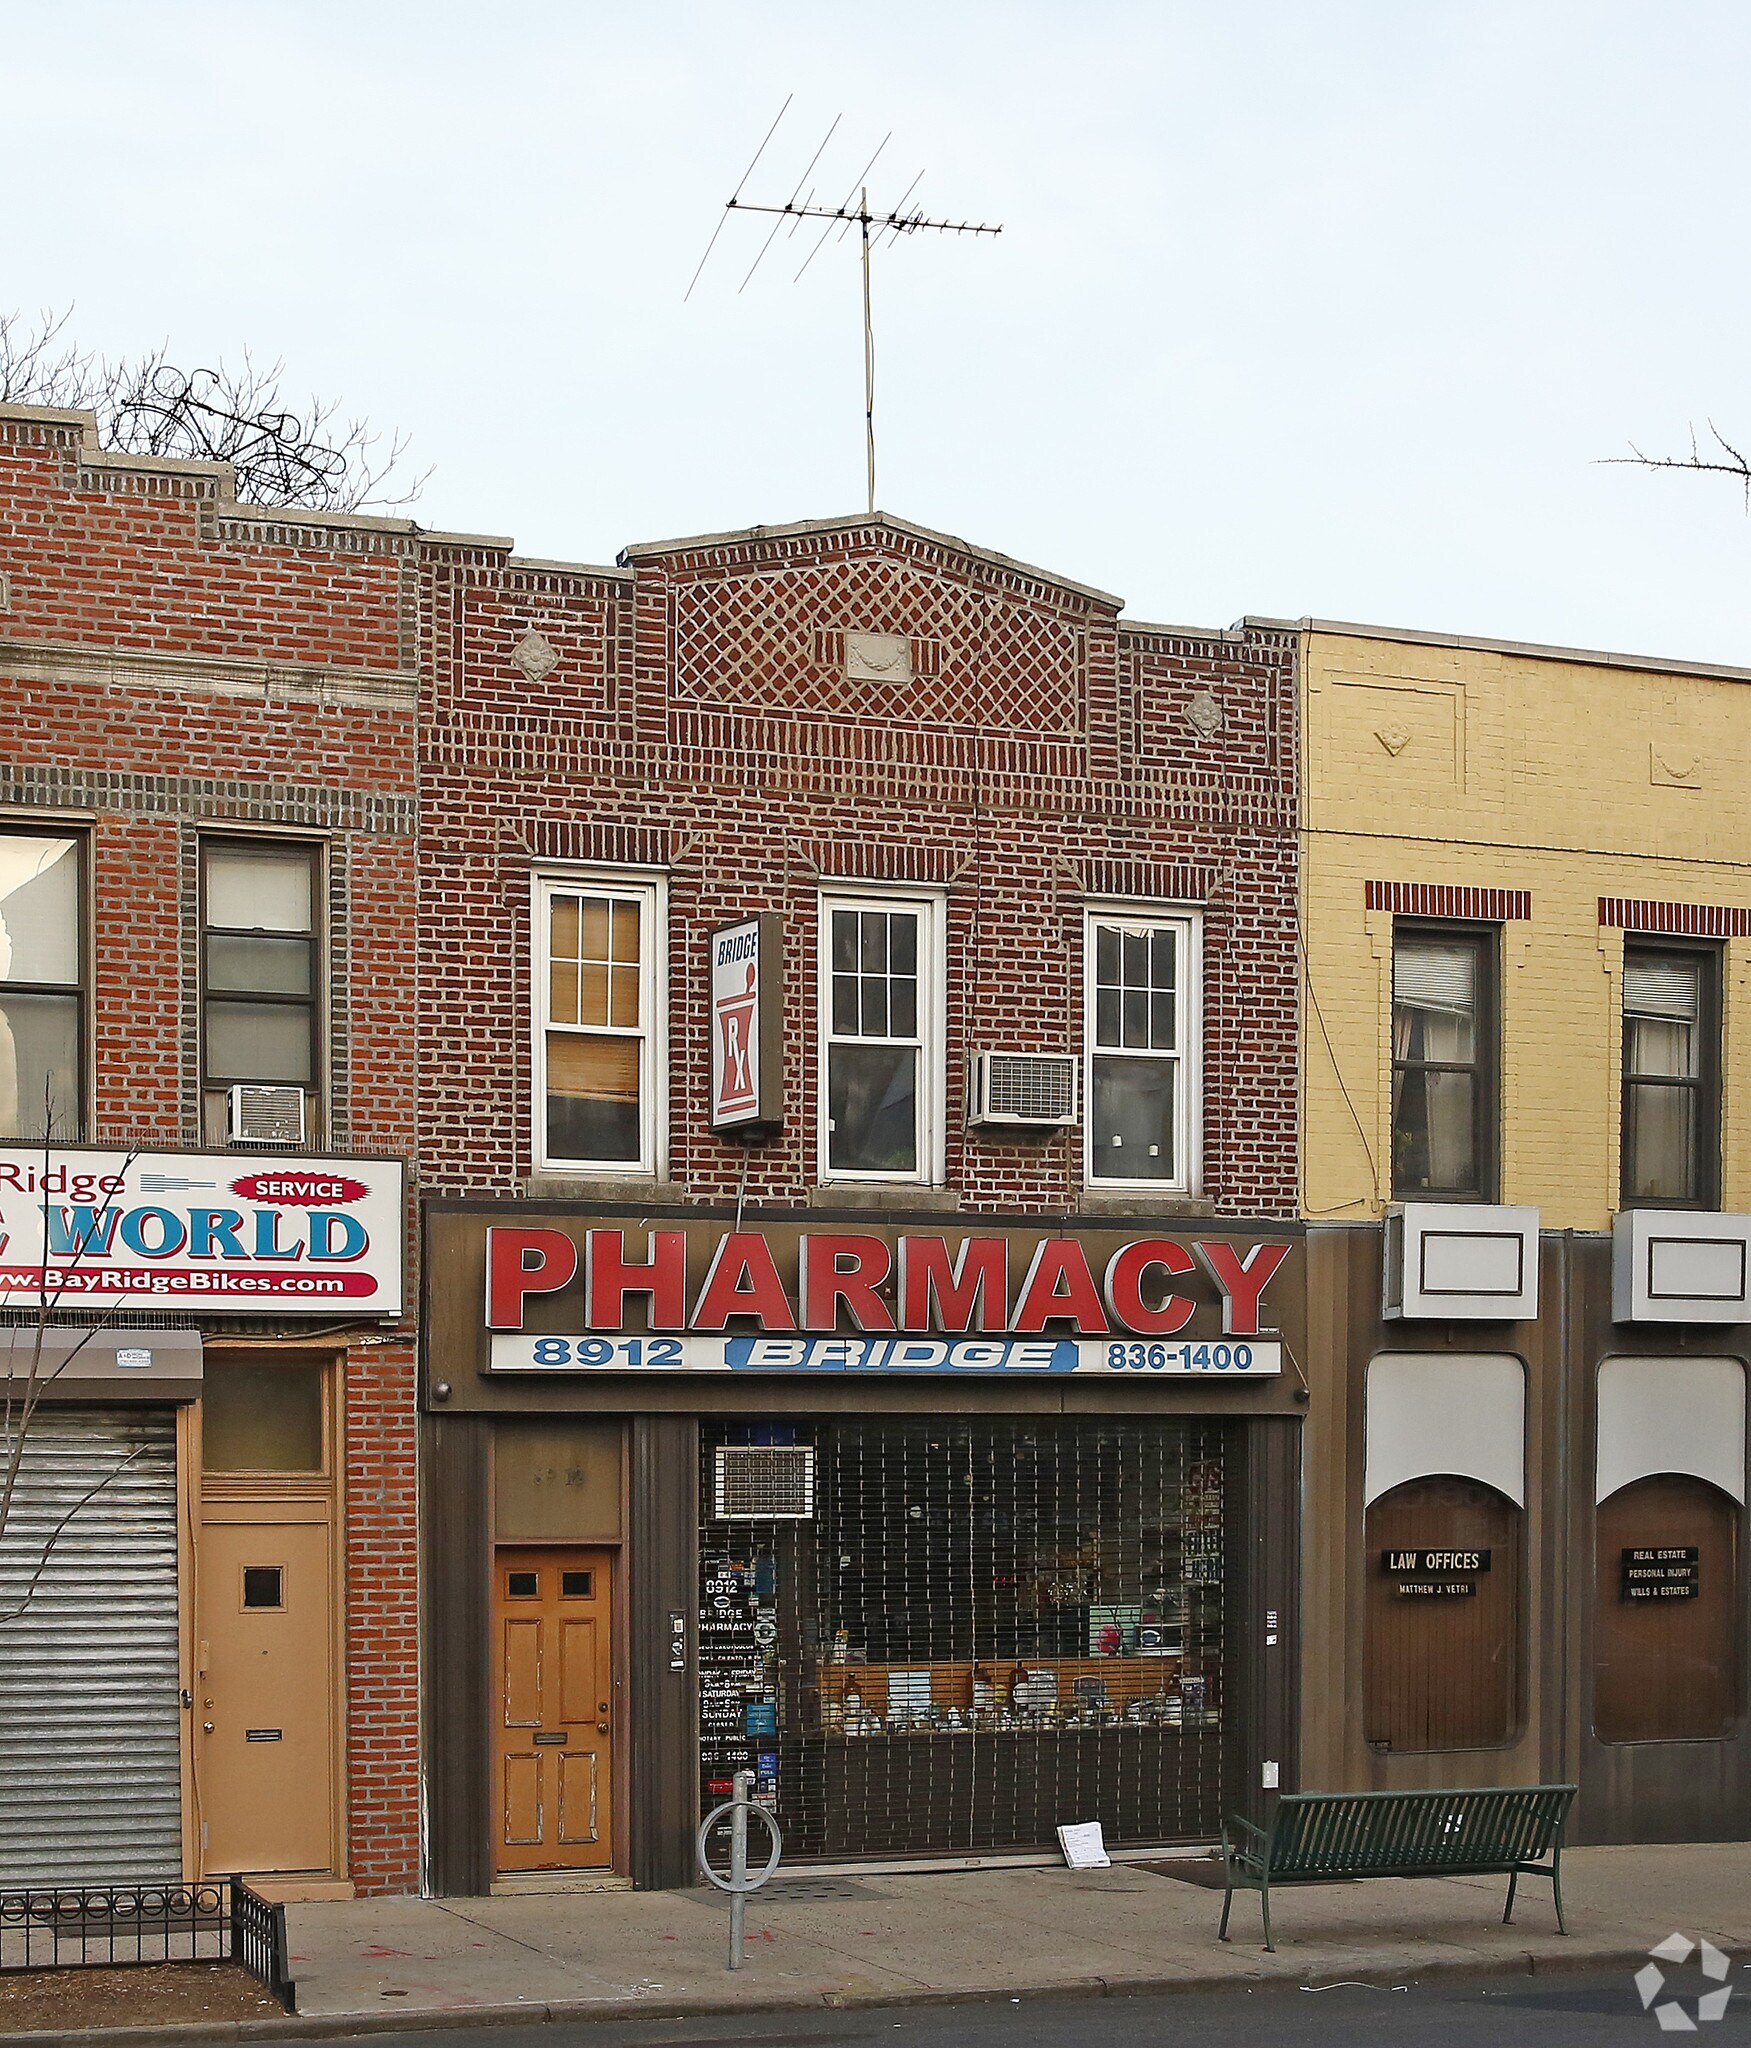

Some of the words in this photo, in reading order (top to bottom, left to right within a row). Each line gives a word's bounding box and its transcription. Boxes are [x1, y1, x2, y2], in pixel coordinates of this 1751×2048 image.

[717, 931, 757, 967] BRIDGE
[255, 1180, 344, 1198] SERVICE
[37, 1204, 370, 1263] WORLD
[0, 1270, 345, 1294] w.BayRidgeBikes.com
[486, 1226, 1293, 1335] PHARMACY
[532, 1338, 684, 1367] 8912
[746, 1339, 1060, 1369] BRIDGE
[1107, 1344, 1254, 1370] 836-1400
[1390, 1552, 1417, 1569] LAW
[1426, 1552, 1480, 1569] OFFICES
[1633, 1551, 1655, 1560] REAL
[1657, 1550, 1687, 1559] ESTATE
[1628, 1568, 1665, 1578] PERSONAL
[1667, 1567, 1692, 1577] INJURY
[705, 1579, 738, 1594] 8912
[1399, 1584, 1434, 1594] MATTHEW
[1630, 1587, 1651, 1596] WILLS
[1652, 1586, 1659, 1596] &
[1660, 1586, 1690, 1596] ESTATES
[698, 1622, 753, 1631] HARMACY
[702, 1689, 740, 1698] SATURDAY
[701, 1708, 743, 1719] SUNDAY
[726, 1751, 749, 1760] 1400
